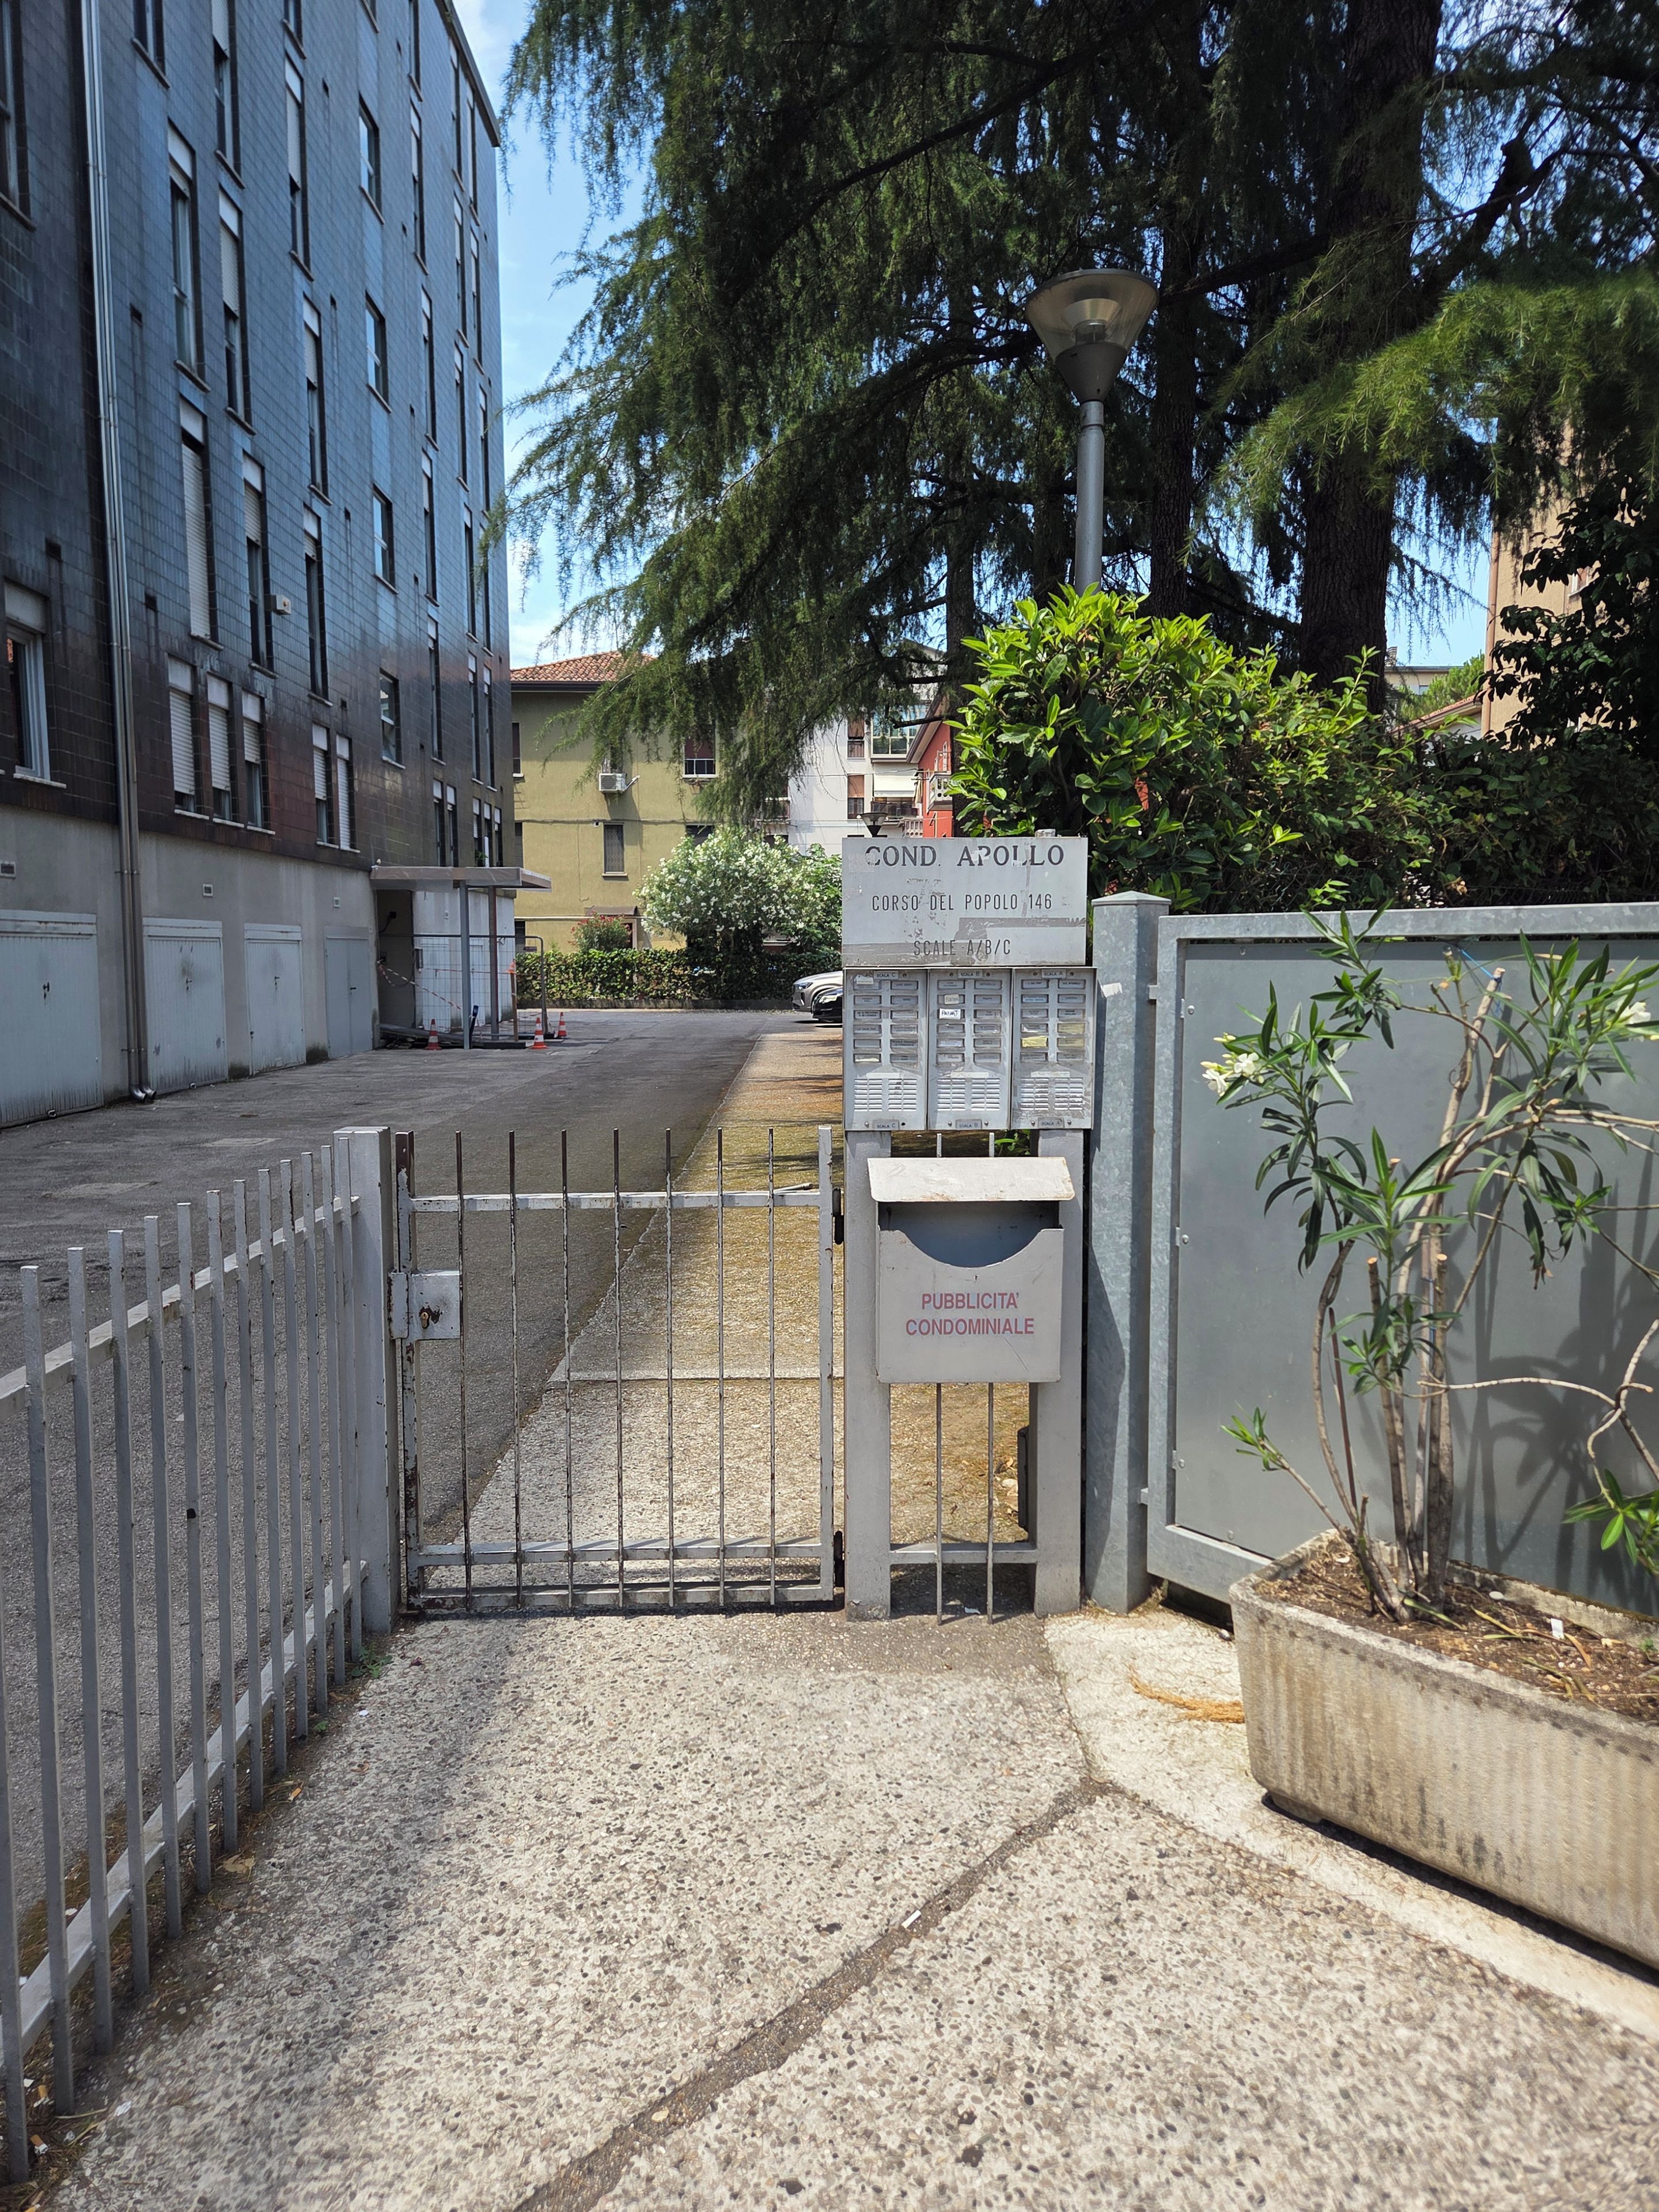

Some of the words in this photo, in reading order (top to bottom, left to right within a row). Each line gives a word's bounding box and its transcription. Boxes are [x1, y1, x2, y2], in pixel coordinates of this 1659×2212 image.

[865, 845, 941, 867] COND.
[957, 844, 1065, 866] APOLLO
[872, 895, 919, 911] CORSO
[930, 895, 954, 911] DEL
[965, 894, 1018, 910] POPOLO
[1029, 893, 1052, 910] 146
[914, 940, 956, 956] SCALE
[967, 939, 1010, 956] A/B/C
[922, 1292, 1019, 1310] PUBBLICITA'
[906, 1317, 1035, 1336] CONDOMINIALE
